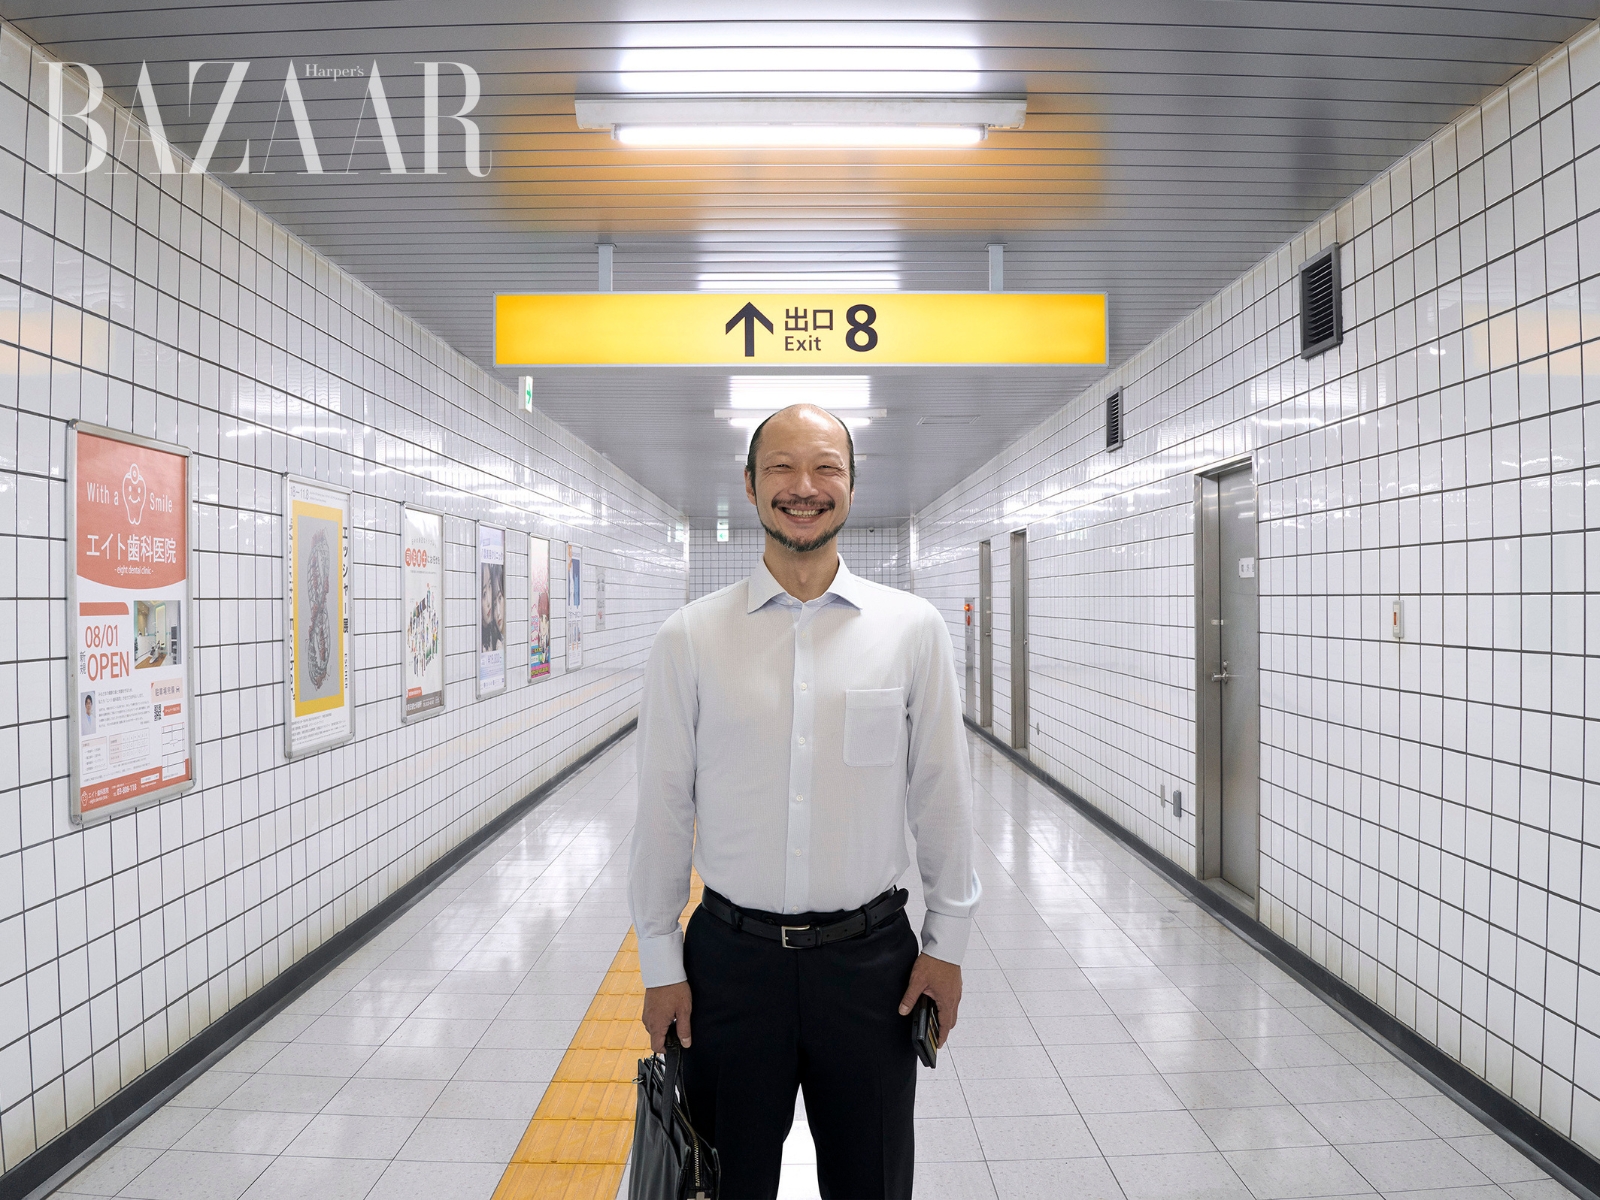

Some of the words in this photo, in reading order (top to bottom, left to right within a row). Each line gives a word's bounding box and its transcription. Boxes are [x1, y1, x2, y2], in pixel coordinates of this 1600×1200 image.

[784, 307, 834, 332] 出口
[845, 303, 879, 353] 8
[784, 335, 822, 352] Exit
[86, 482, 110, 505] With
[113, 492, 119, 506] a
[149, 492, 173, 513] Smile
[86, 533, 177, 564] エイト歯科医院
[85, 624, 118, 649] 08/01
[87, 652, 130, 682] OPEN
